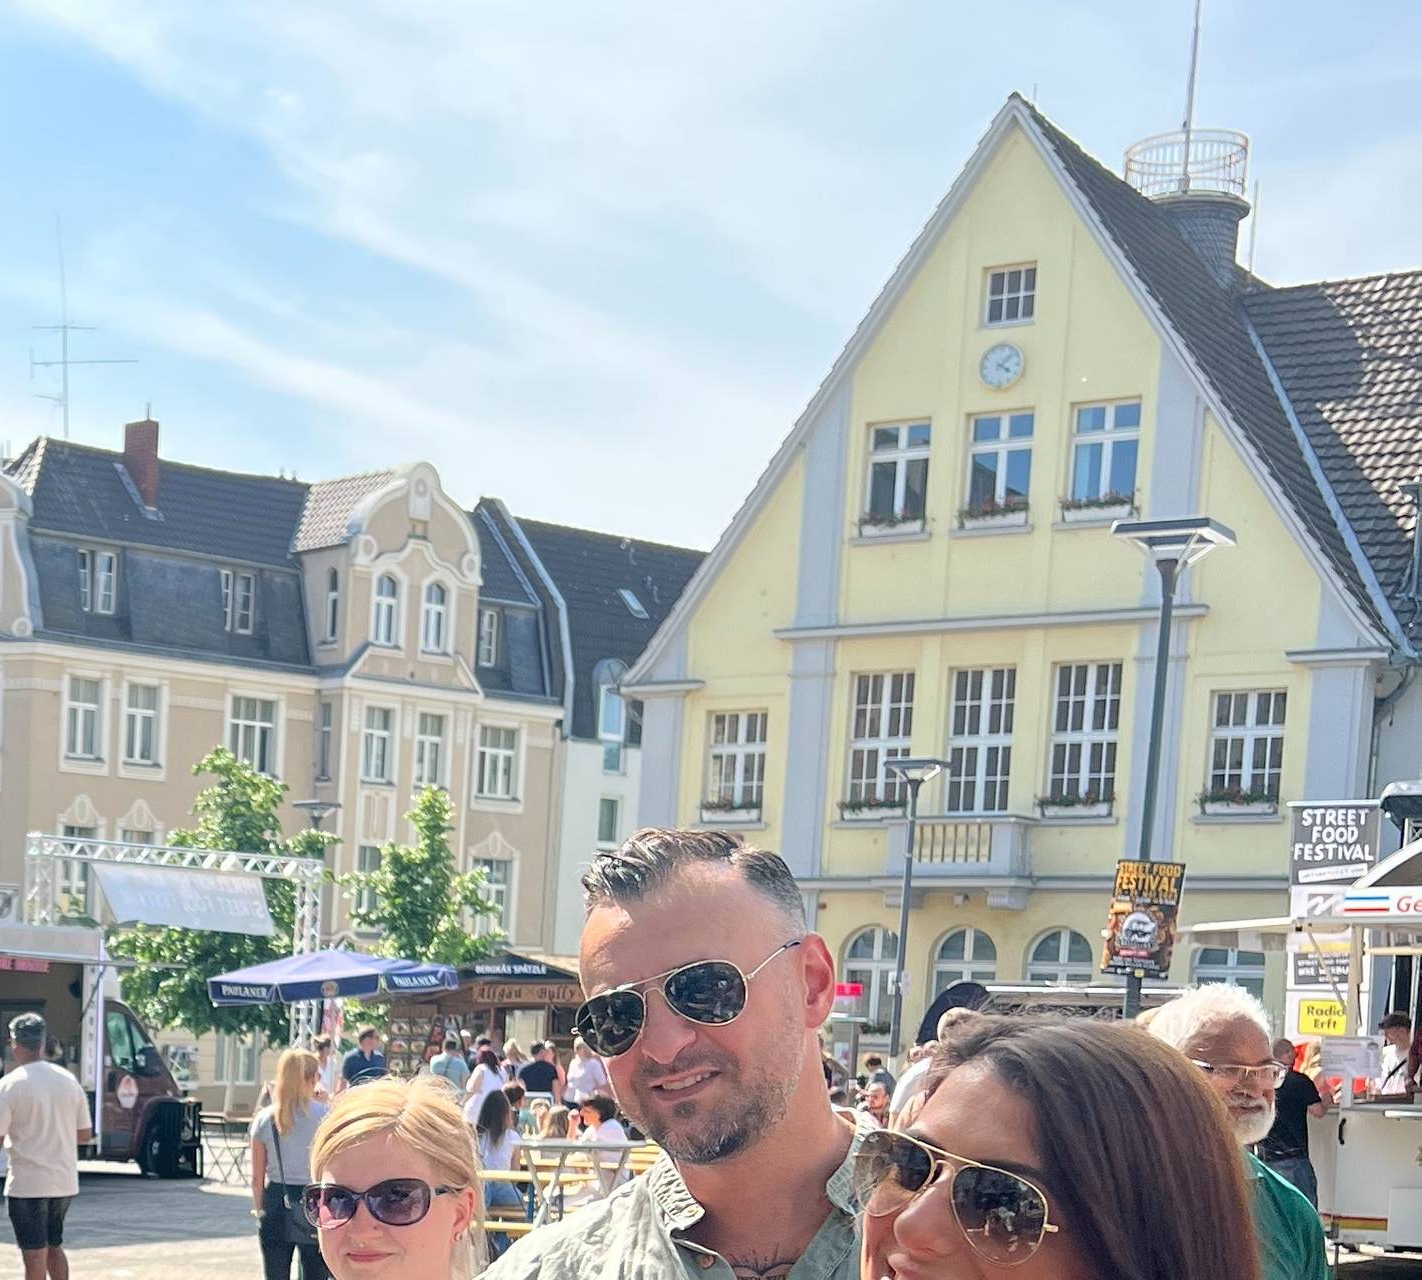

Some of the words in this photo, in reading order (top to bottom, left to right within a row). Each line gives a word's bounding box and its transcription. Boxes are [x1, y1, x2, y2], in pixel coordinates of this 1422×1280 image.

[1301, 808, 1370, 826] STREET
[1312, 825, 1359, 843] FOOD
[1294, 842, 1375, 861] FESTIVAL
[1115, 873, 1178, 897] FESTIVAL
[392, 974, 439, 987] PAULANER
[221, 985, 267, 998] PAULANER
